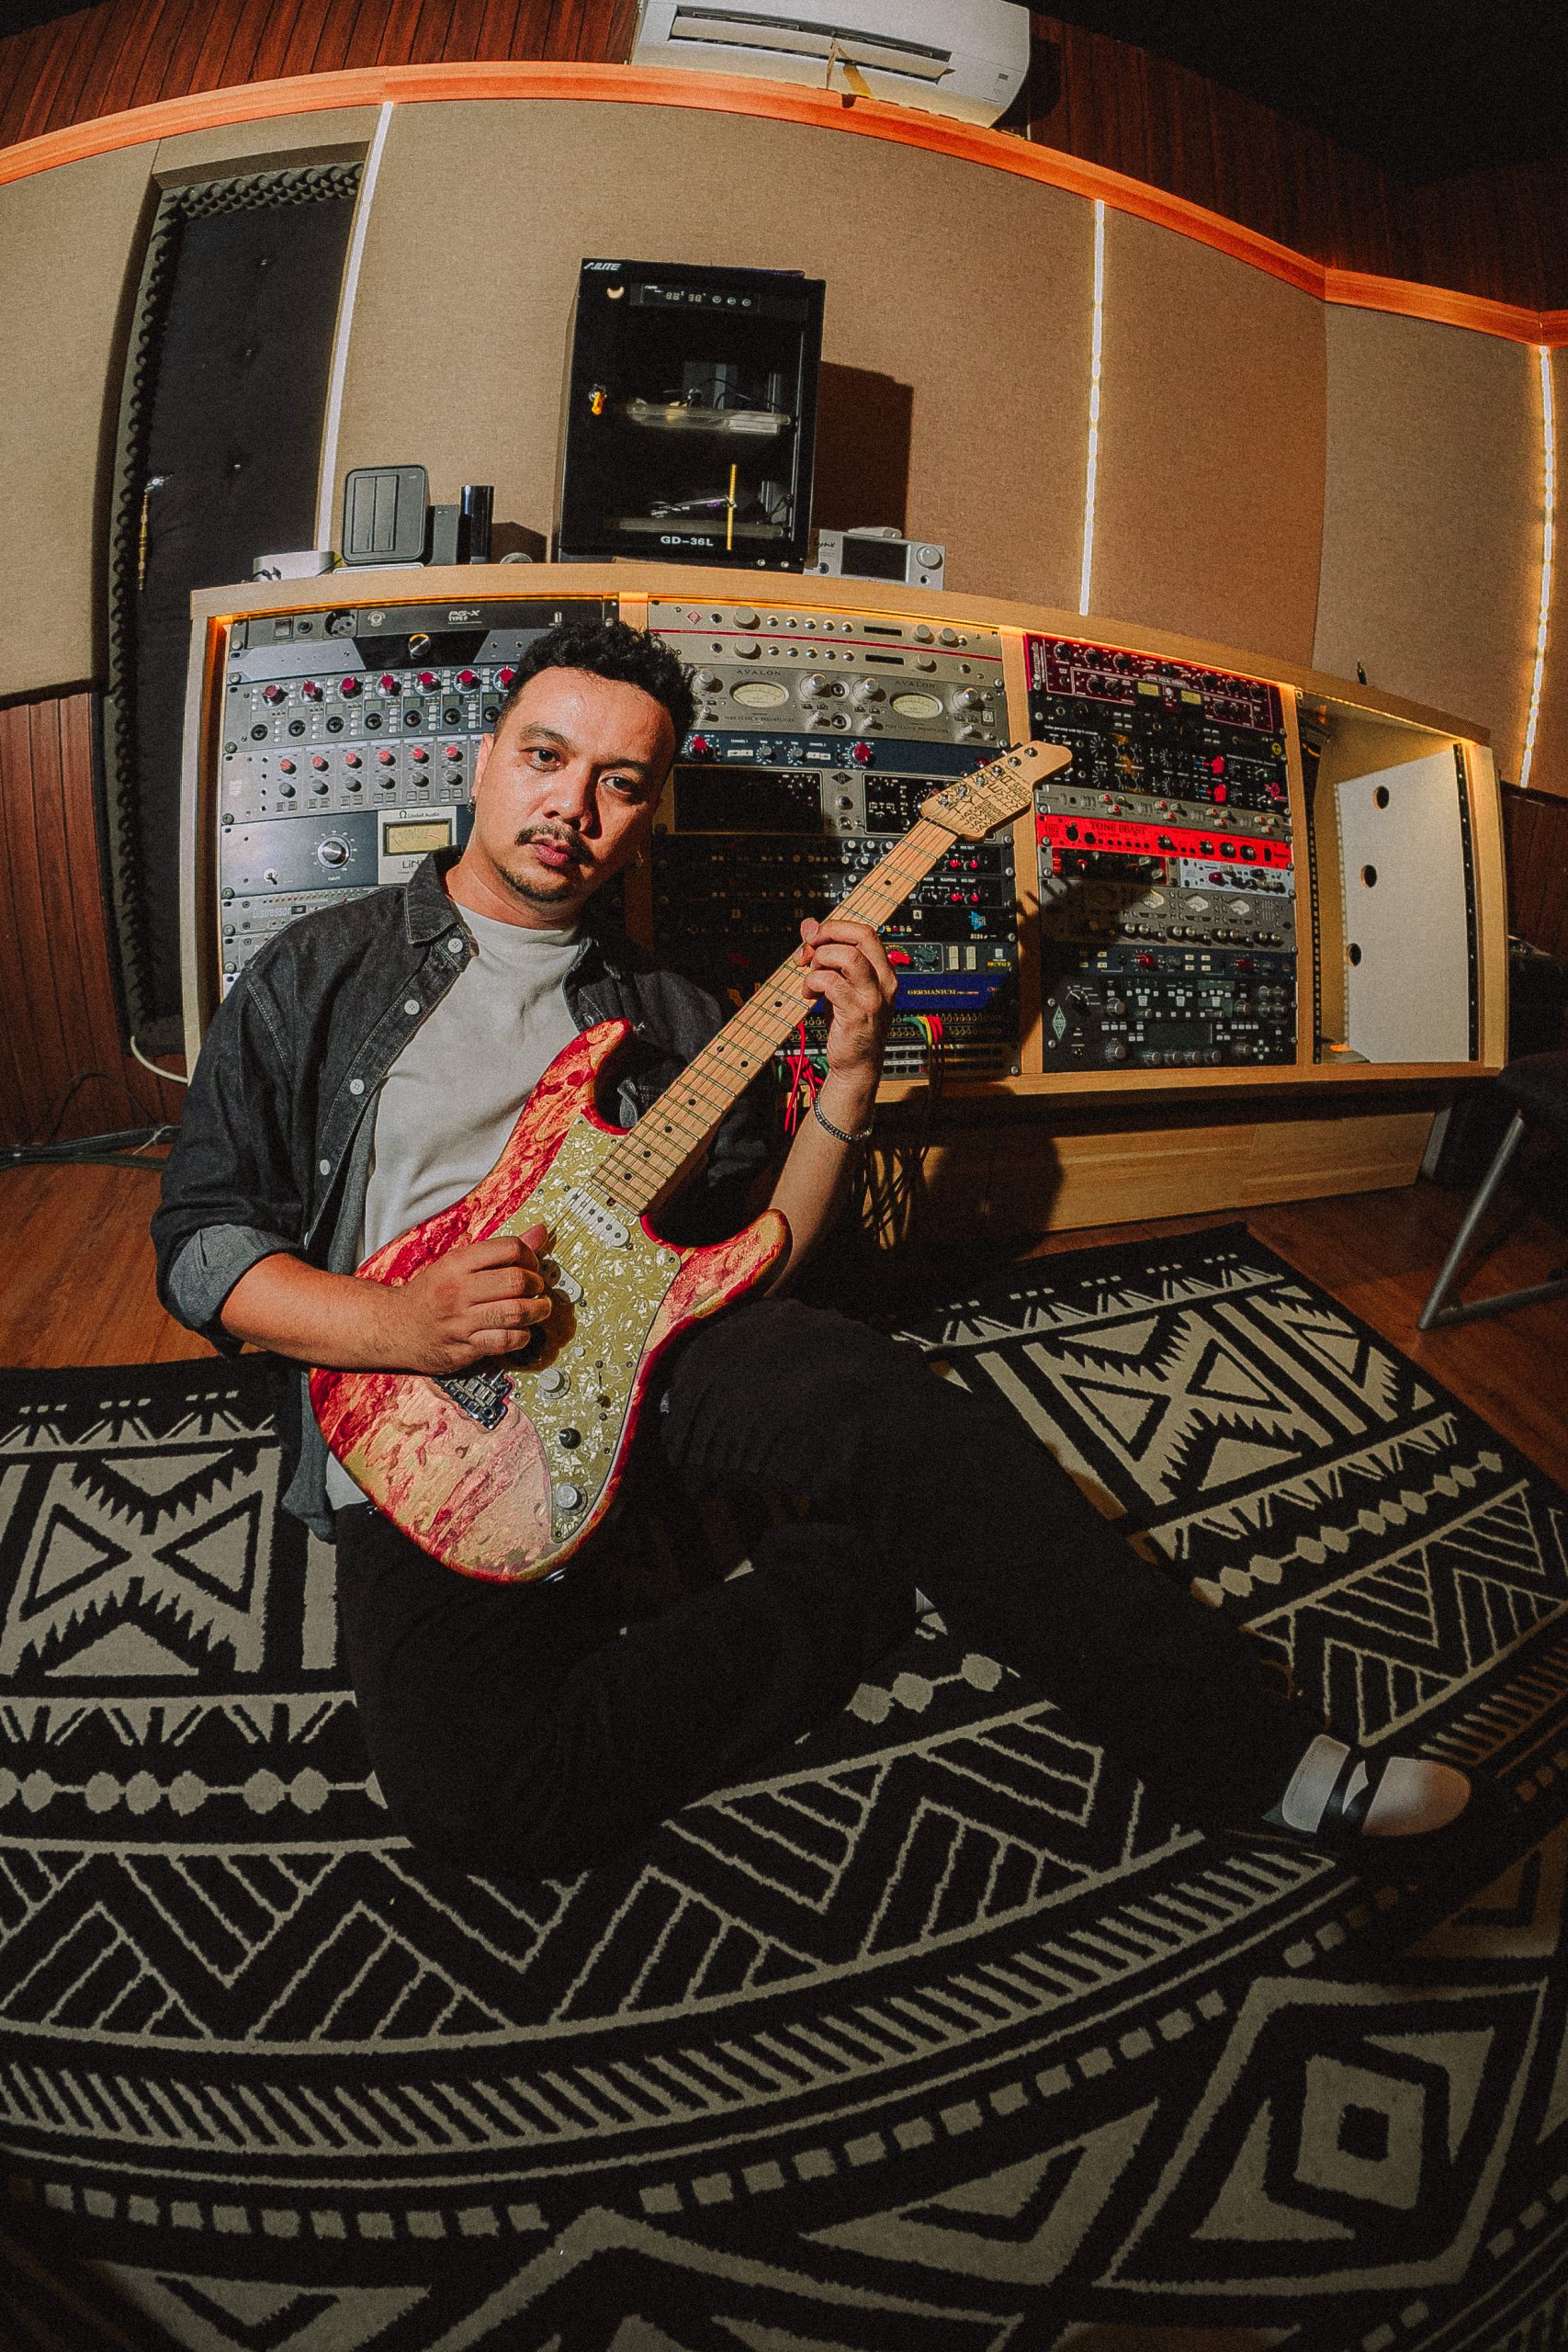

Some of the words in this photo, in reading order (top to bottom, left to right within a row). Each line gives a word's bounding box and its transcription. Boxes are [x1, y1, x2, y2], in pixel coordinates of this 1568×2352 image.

[660, 536, 714, 547] GD-36L
[736, 669, 781, 677] AVALON
[895, 681, 936, 689] AVALON
[948, 775, 1016, 814] TYLER
[1089, 820, 1117, 831] TONE
